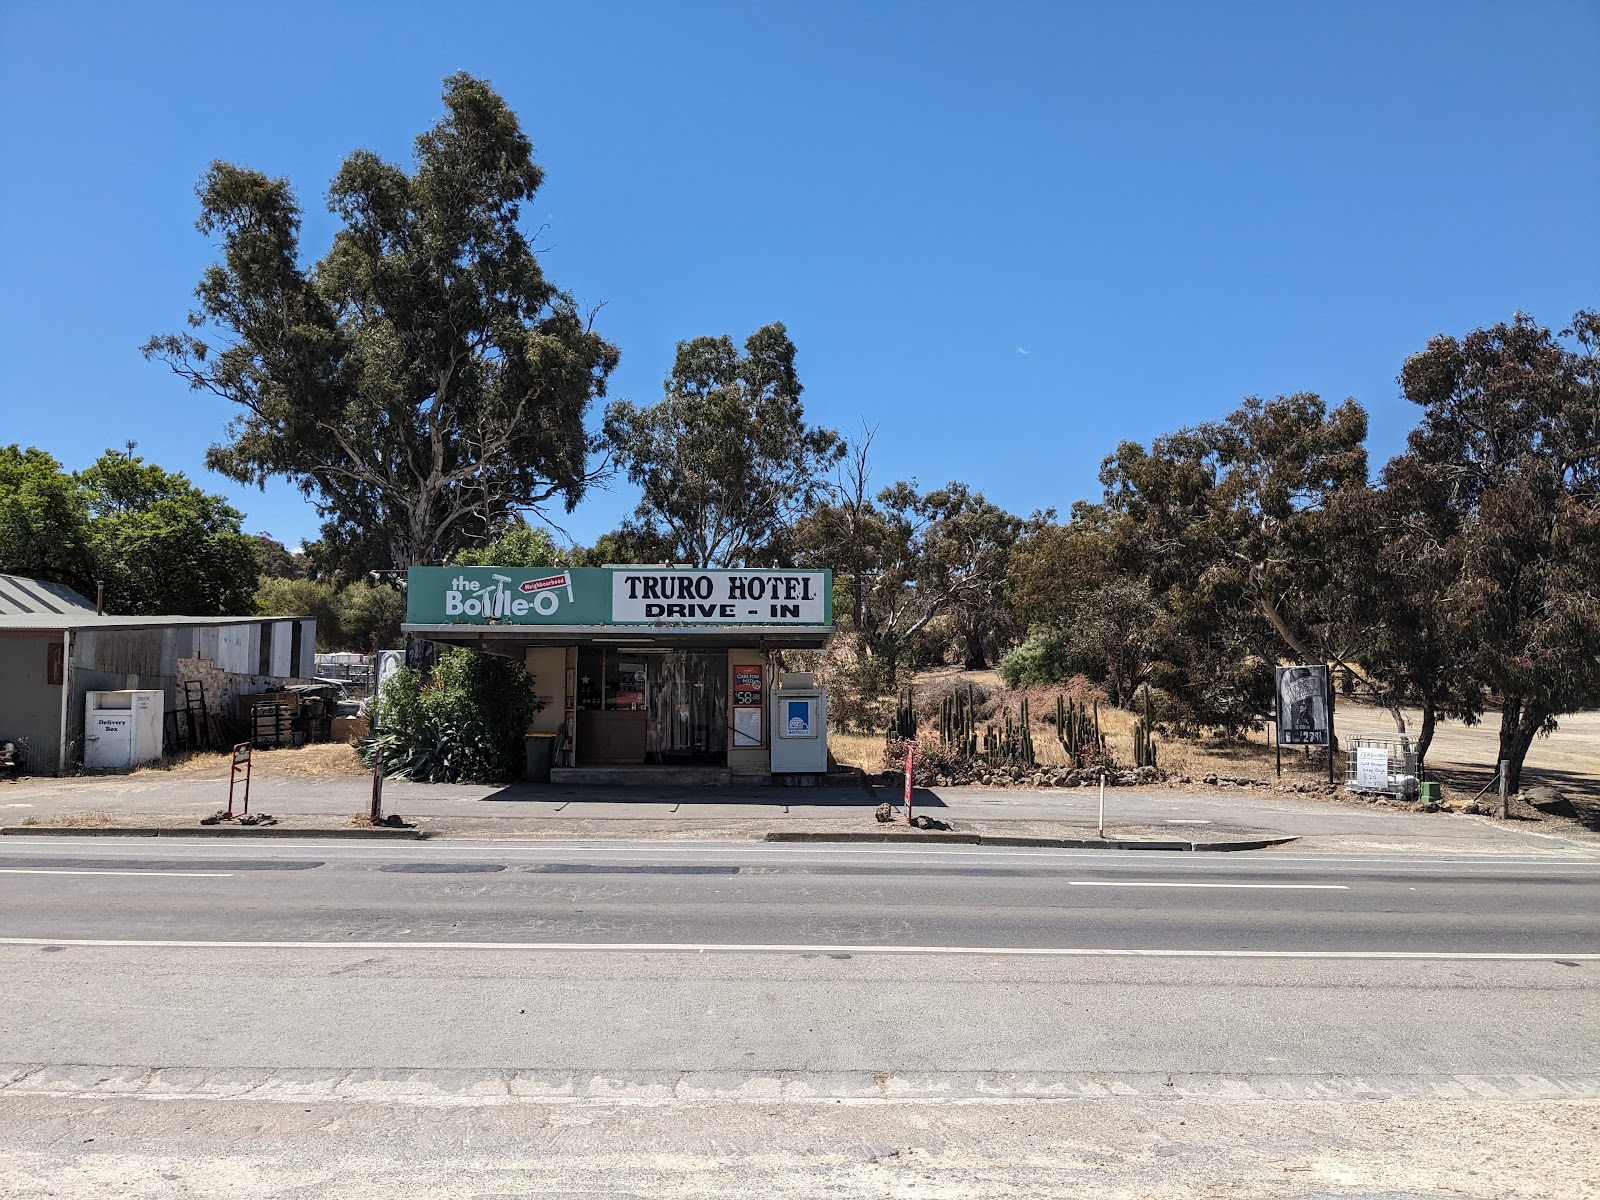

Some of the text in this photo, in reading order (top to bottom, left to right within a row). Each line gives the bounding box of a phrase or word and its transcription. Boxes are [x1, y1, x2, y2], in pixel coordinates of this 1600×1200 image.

[452, 576, 480, 590] the
[524, 578, 565, 590] Neighbourhood
[625, 576, 816, 600] TRURO HOTEL
[645, 604, 736, 618] DRIVE
[770, 604, 800, 618] IN
